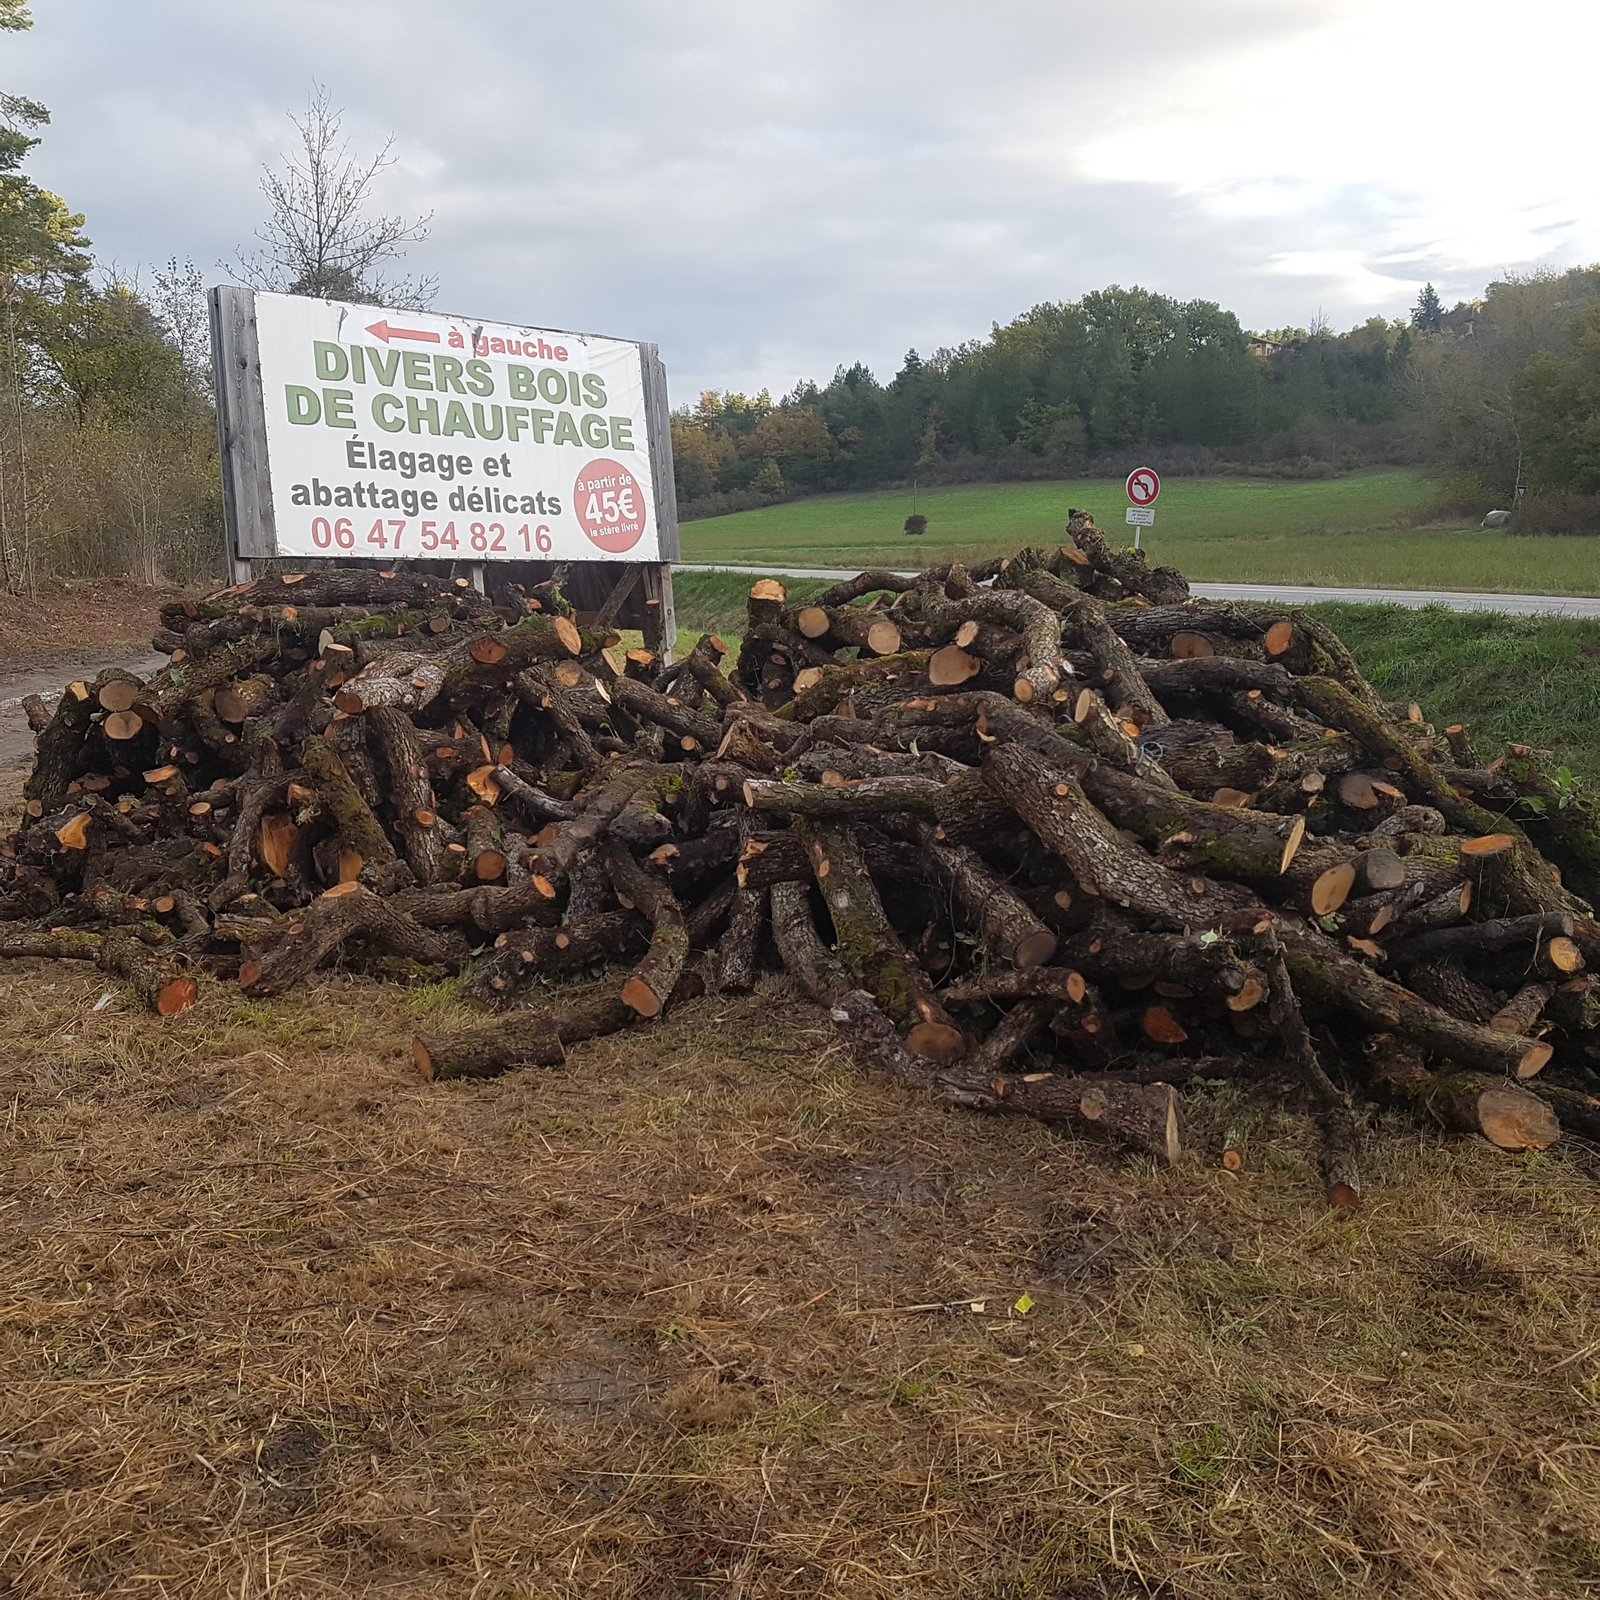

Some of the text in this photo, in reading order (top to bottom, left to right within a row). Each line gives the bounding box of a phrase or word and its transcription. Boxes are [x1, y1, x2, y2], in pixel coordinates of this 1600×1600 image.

[448, 326, 568, 362] à gauche
[313, 340, 608, 409] DIVERS BOIS
[284, 384, 635, 451] DE CHAUFFAGE
[345, 434, 512, 481] Élagage et
[291, 478, 562, 517] abattage délicats
[577, 473, 632, 493] à partir de
[585, 488, 638, 524] 45€
[311, 516, 552, 553] 06 47 54 82 16
[589, 521, 639, 537] le stère livré
